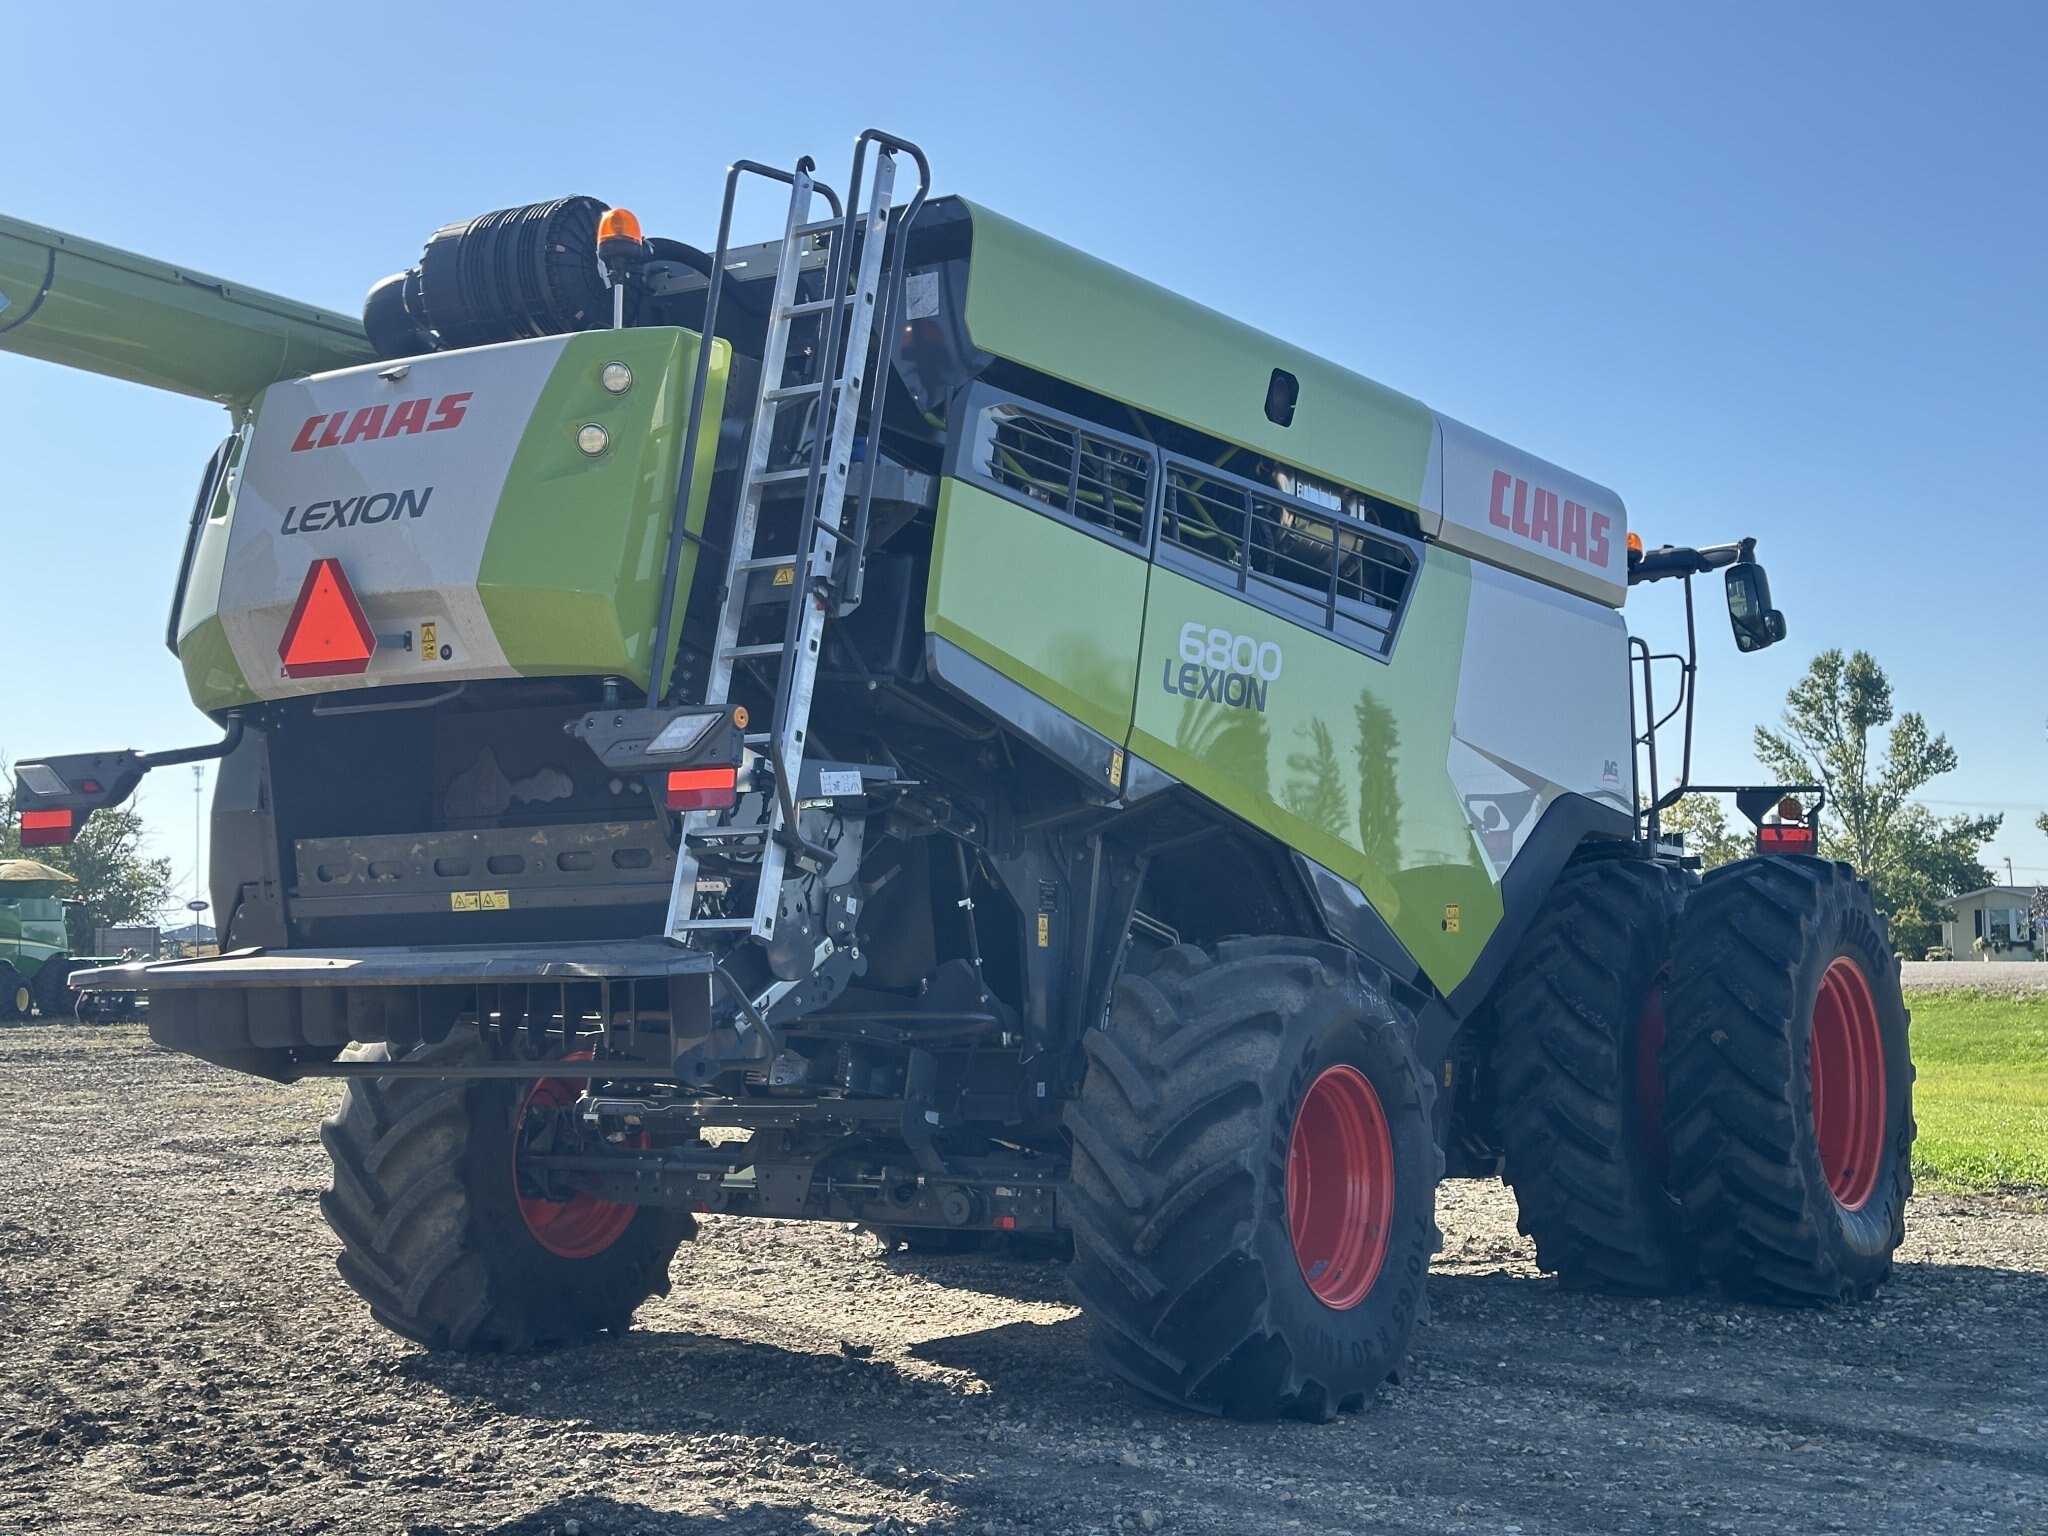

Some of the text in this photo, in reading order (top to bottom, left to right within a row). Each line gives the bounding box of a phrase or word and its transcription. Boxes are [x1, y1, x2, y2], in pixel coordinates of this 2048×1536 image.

[290, 391, 474, 452] CLAAS
[280, 486, 434, 536] LEXION
[1489, 469, 1611, 568] CLAAS
[1179, 621, 1283, 682] 6800
[1163, 658, 1269, 712] LEXION
